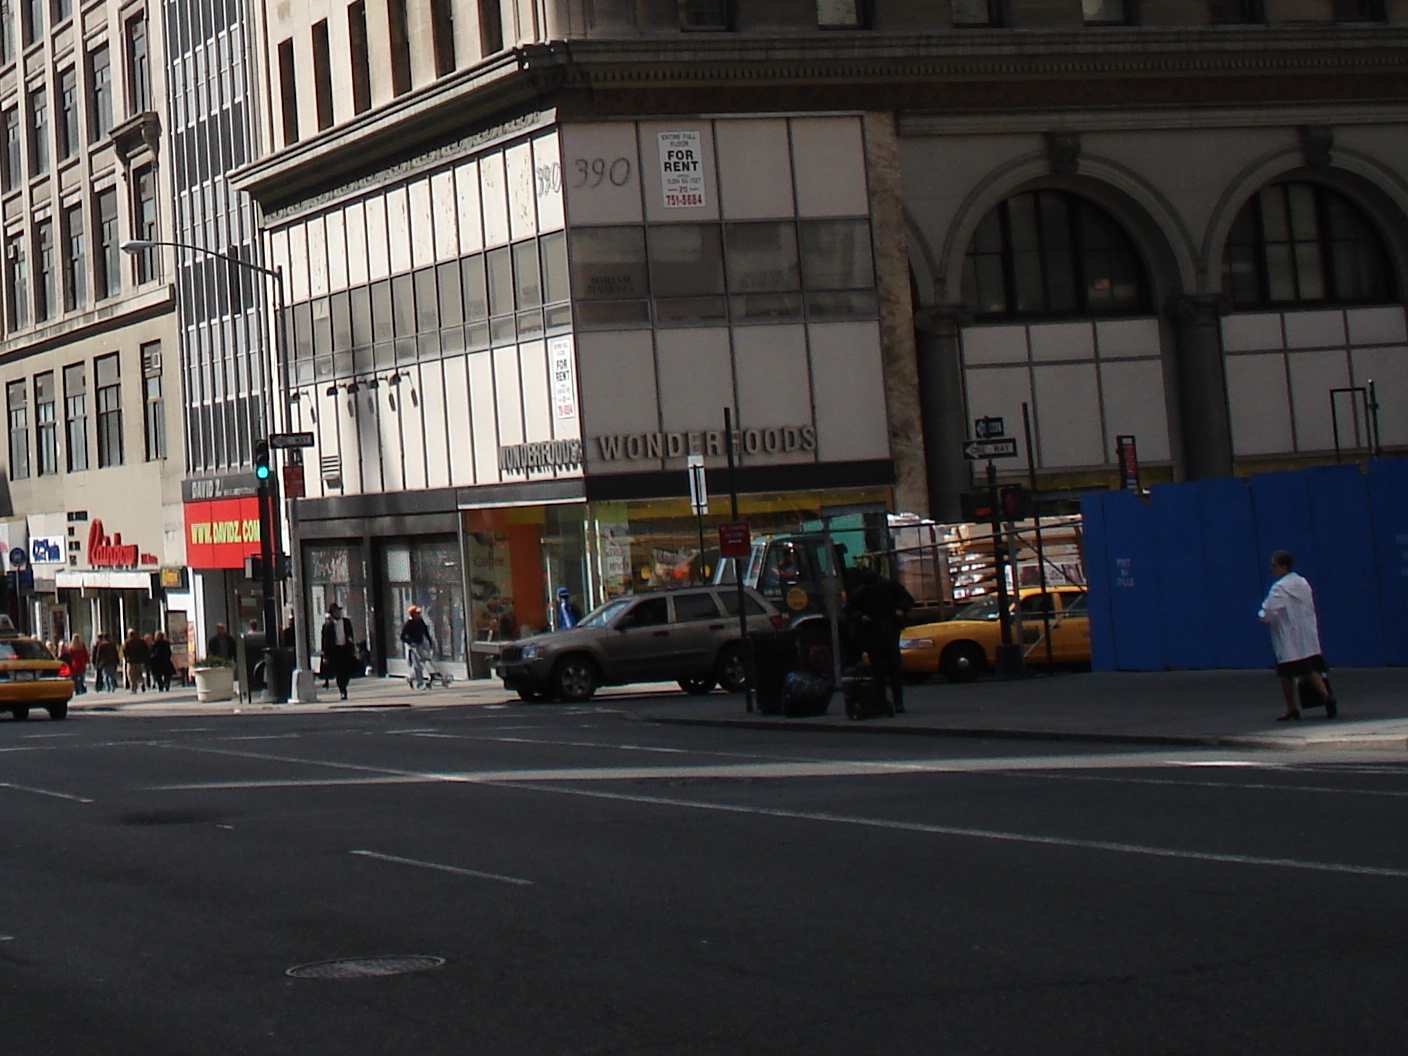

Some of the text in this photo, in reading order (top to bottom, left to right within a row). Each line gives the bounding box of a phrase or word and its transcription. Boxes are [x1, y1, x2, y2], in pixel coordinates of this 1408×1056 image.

[668, 150, 694, 161] FOR
[573, 157, 631, 189] 390
[664, 161, 699, 172] RENT
[536, 161, 562, 198] 390
[993, 443, 1010, 453] WAY
[192, 480, 214, 499] DAVID
